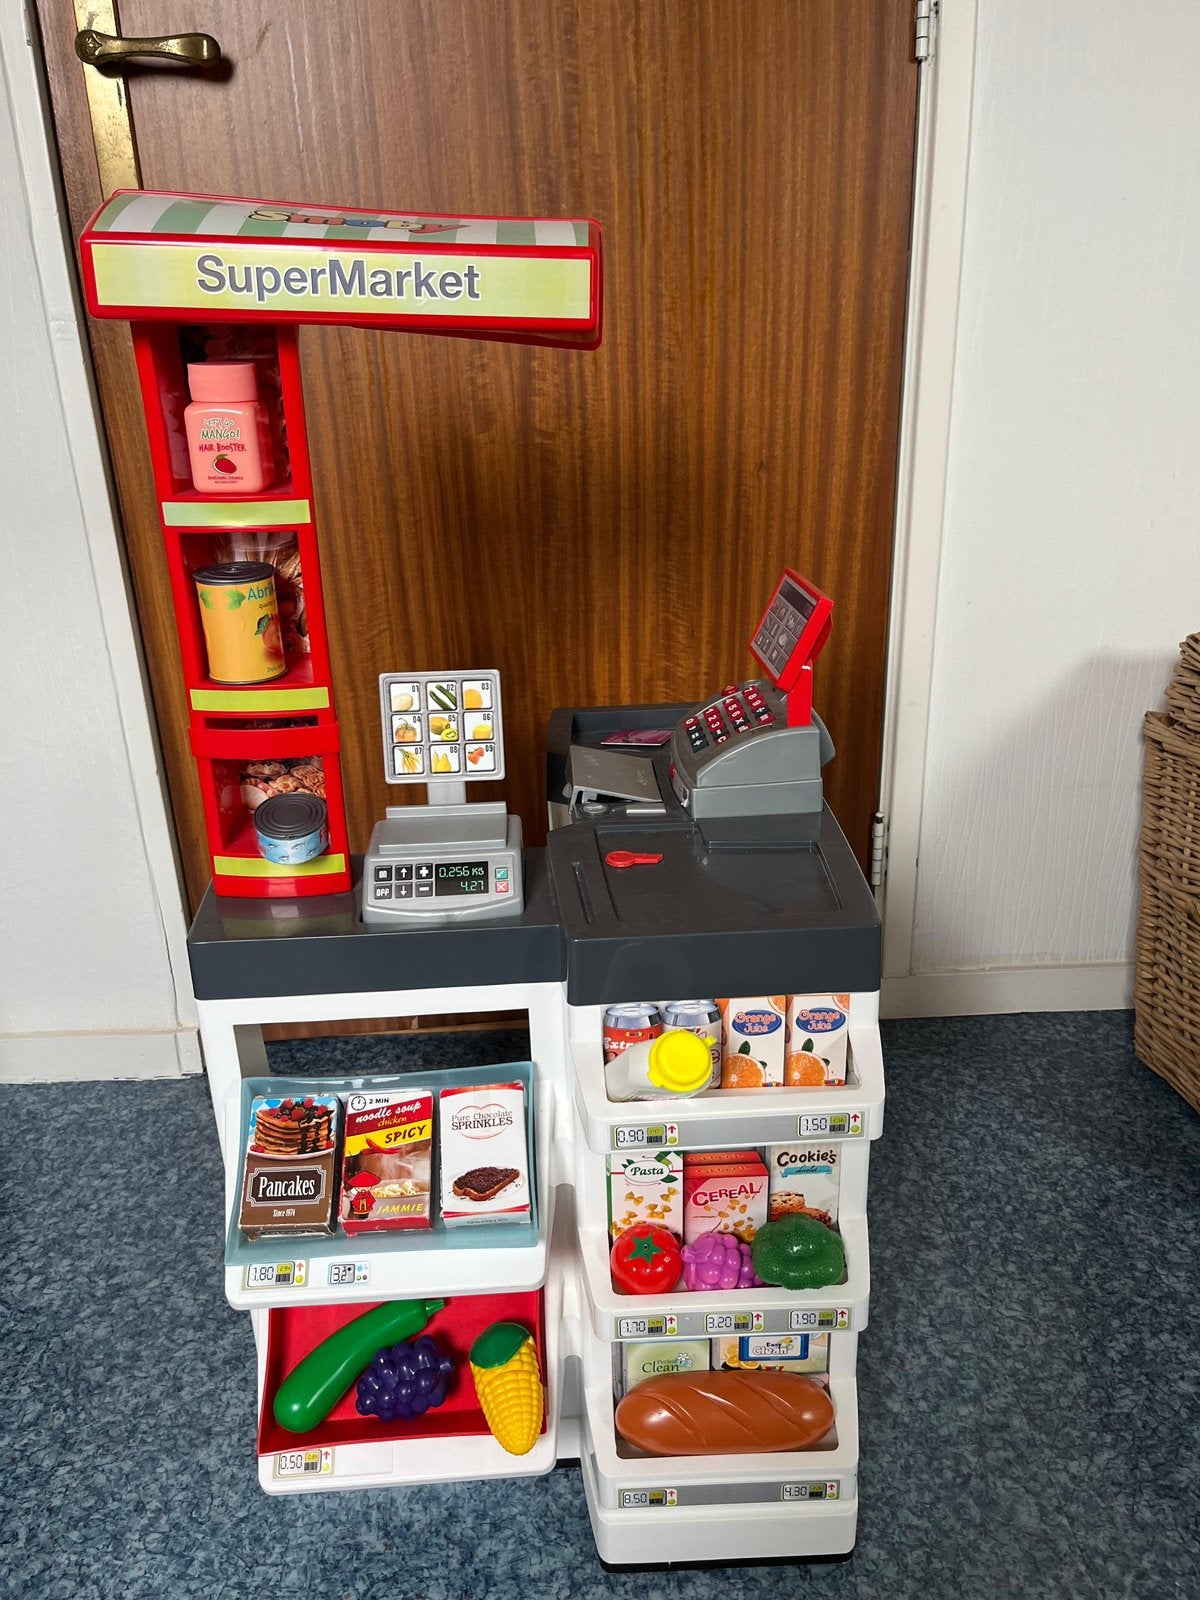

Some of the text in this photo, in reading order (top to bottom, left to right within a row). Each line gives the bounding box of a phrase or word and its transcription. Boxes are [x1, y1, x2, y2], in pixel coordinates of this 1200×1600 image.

[247, 209, 471, 234] Smoby
[196, 253, 481, 302] SuperMarket
[201, 428, 240, 440] MANGO!
[199, 443, 247, 452] HAIR BOOSTER
[447, 684, 454, 692] 02
[482, 713, 491, 721] 06
[708, 714, 717, 722] 2
[717, 735, 726, 743] C
[415, 747, 422, 755] 07
[439, 866, 470, 877] 0.256
[460, 880, 484, 891] 4.27
[376, 888, 389, 897] OFF
[735, 1011, 777, 1024] Orange
[799, 1009, 840, 1022] Orange
[744, 1022, 768, 1033] Juice
[808, 1020, 832, 1030] Juice
[604, 1037, 634, 1050] Extr
[356, 1101, 421, 1123] noodle soup
[473, 1110, 513, 1120] Chocolate
[378, 1115, 407, 1127] chicken
[452, 1116, 513, 1131] SPRINKLES
[385, 1125, 426, 1144] SPICY
[777, 1150, 837, 1167] Cookie's
[630, 1167, 664, 1176] Pasta
[258, 1175, 315, 1198] Pancakes
[692, 1182, 760, 1206] CEREAL
[273, 1209, 285, 1217] Since
[377, 1203, 423, 1214] JAMMIE
[753, 1346, 788, 1355] Clean
[642, 1361, 680, 1373] Clean
